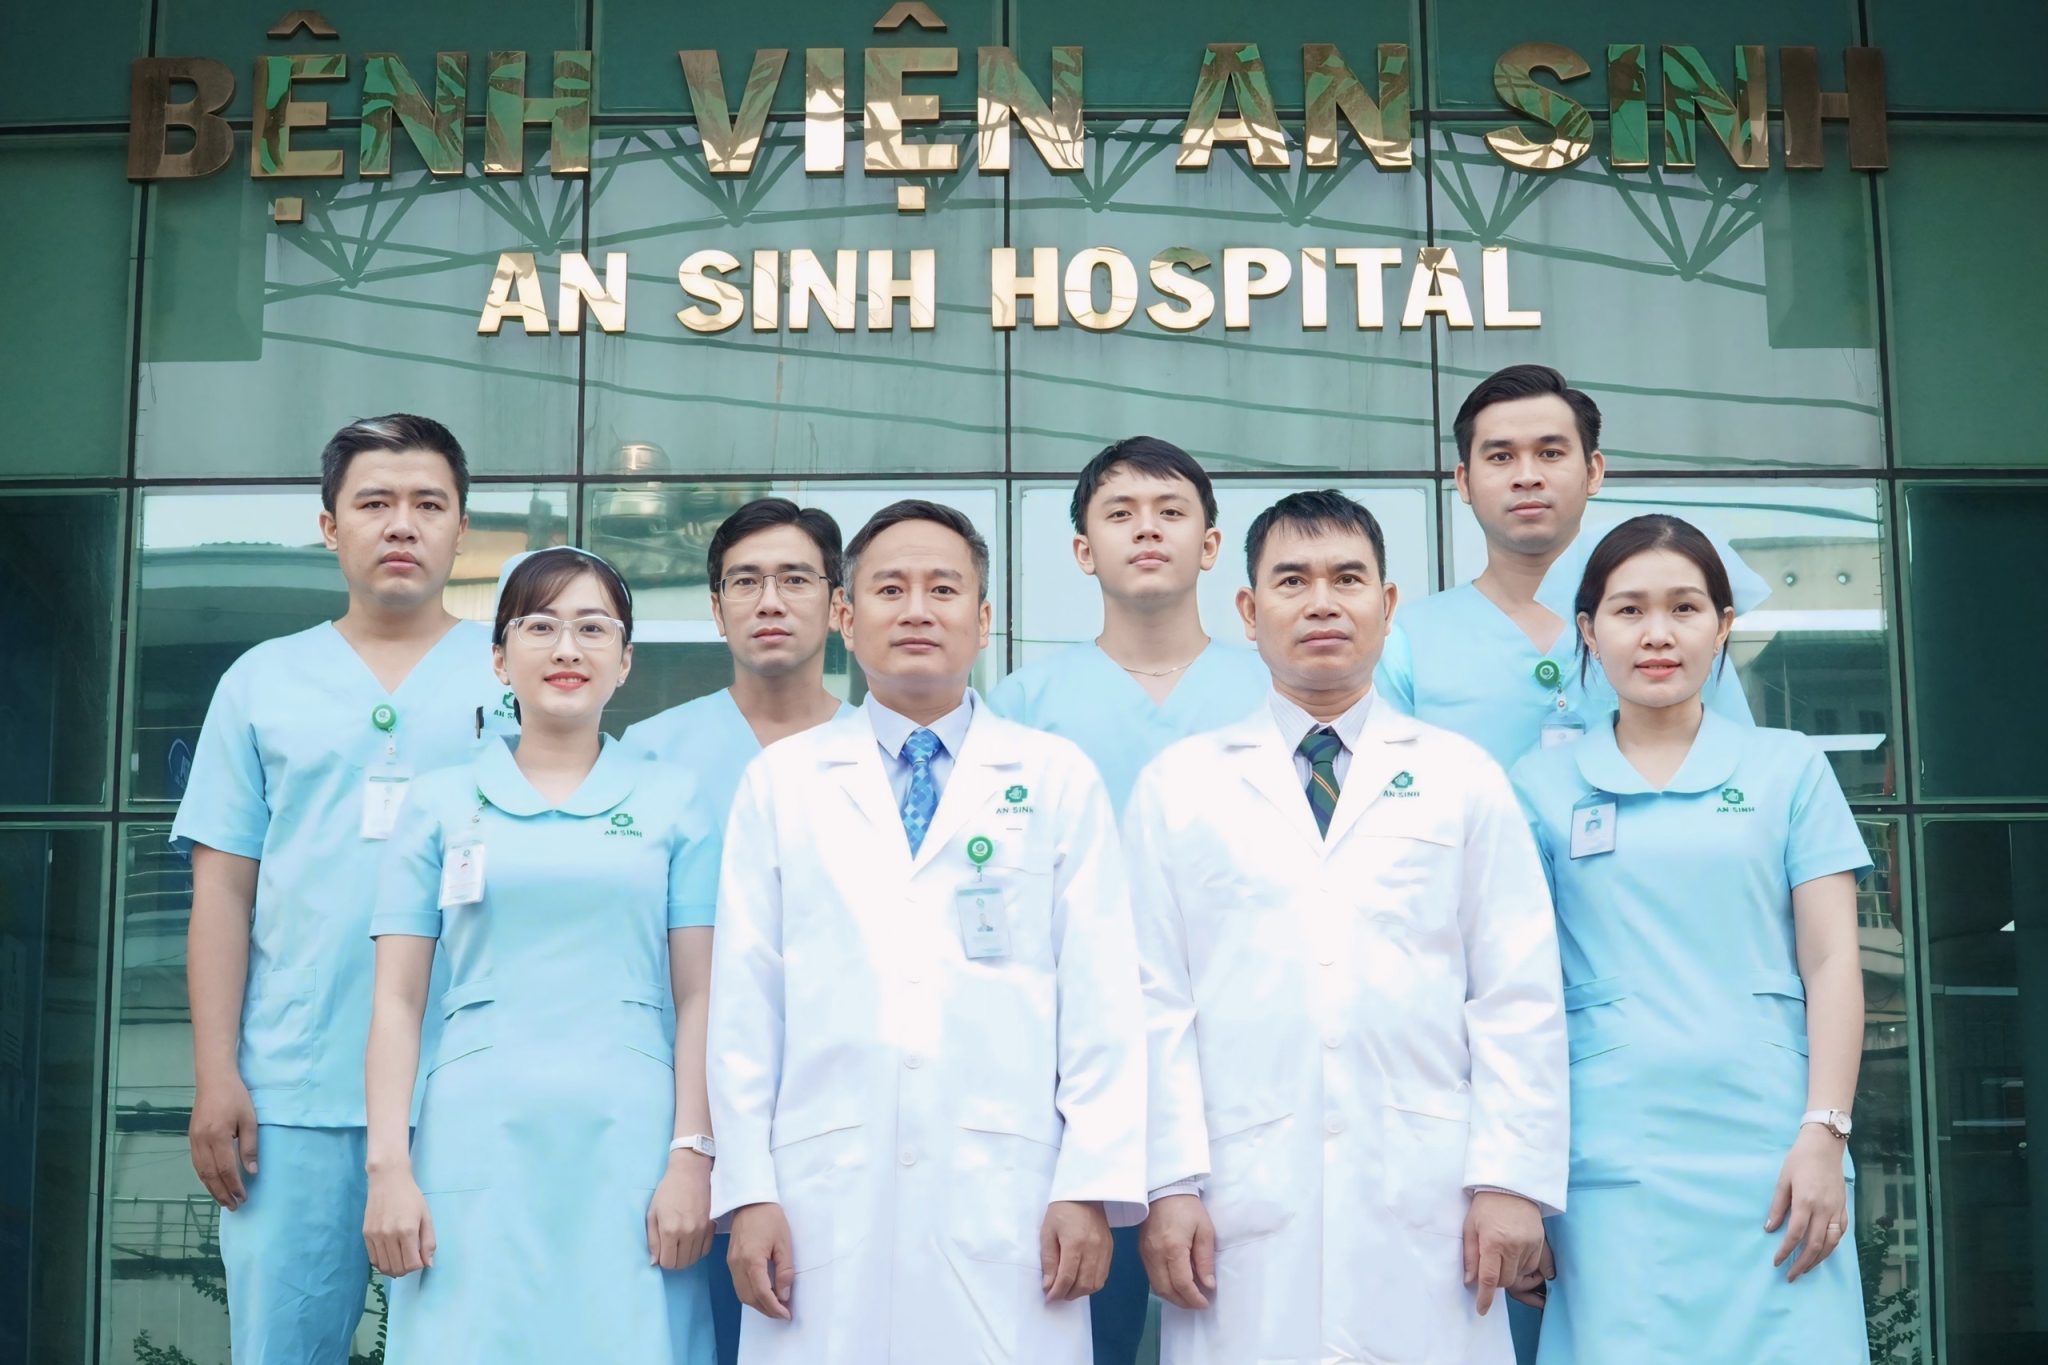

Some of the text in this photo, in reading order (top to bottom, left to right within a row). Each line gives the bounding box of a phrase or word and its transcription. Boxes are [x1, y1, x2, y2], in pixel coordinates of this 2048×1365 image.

[126, 0, 1890, 225] BỆNH VIỆN AN SINH
[477, 245, 1543, 336] AN SINH HOSPITAL
